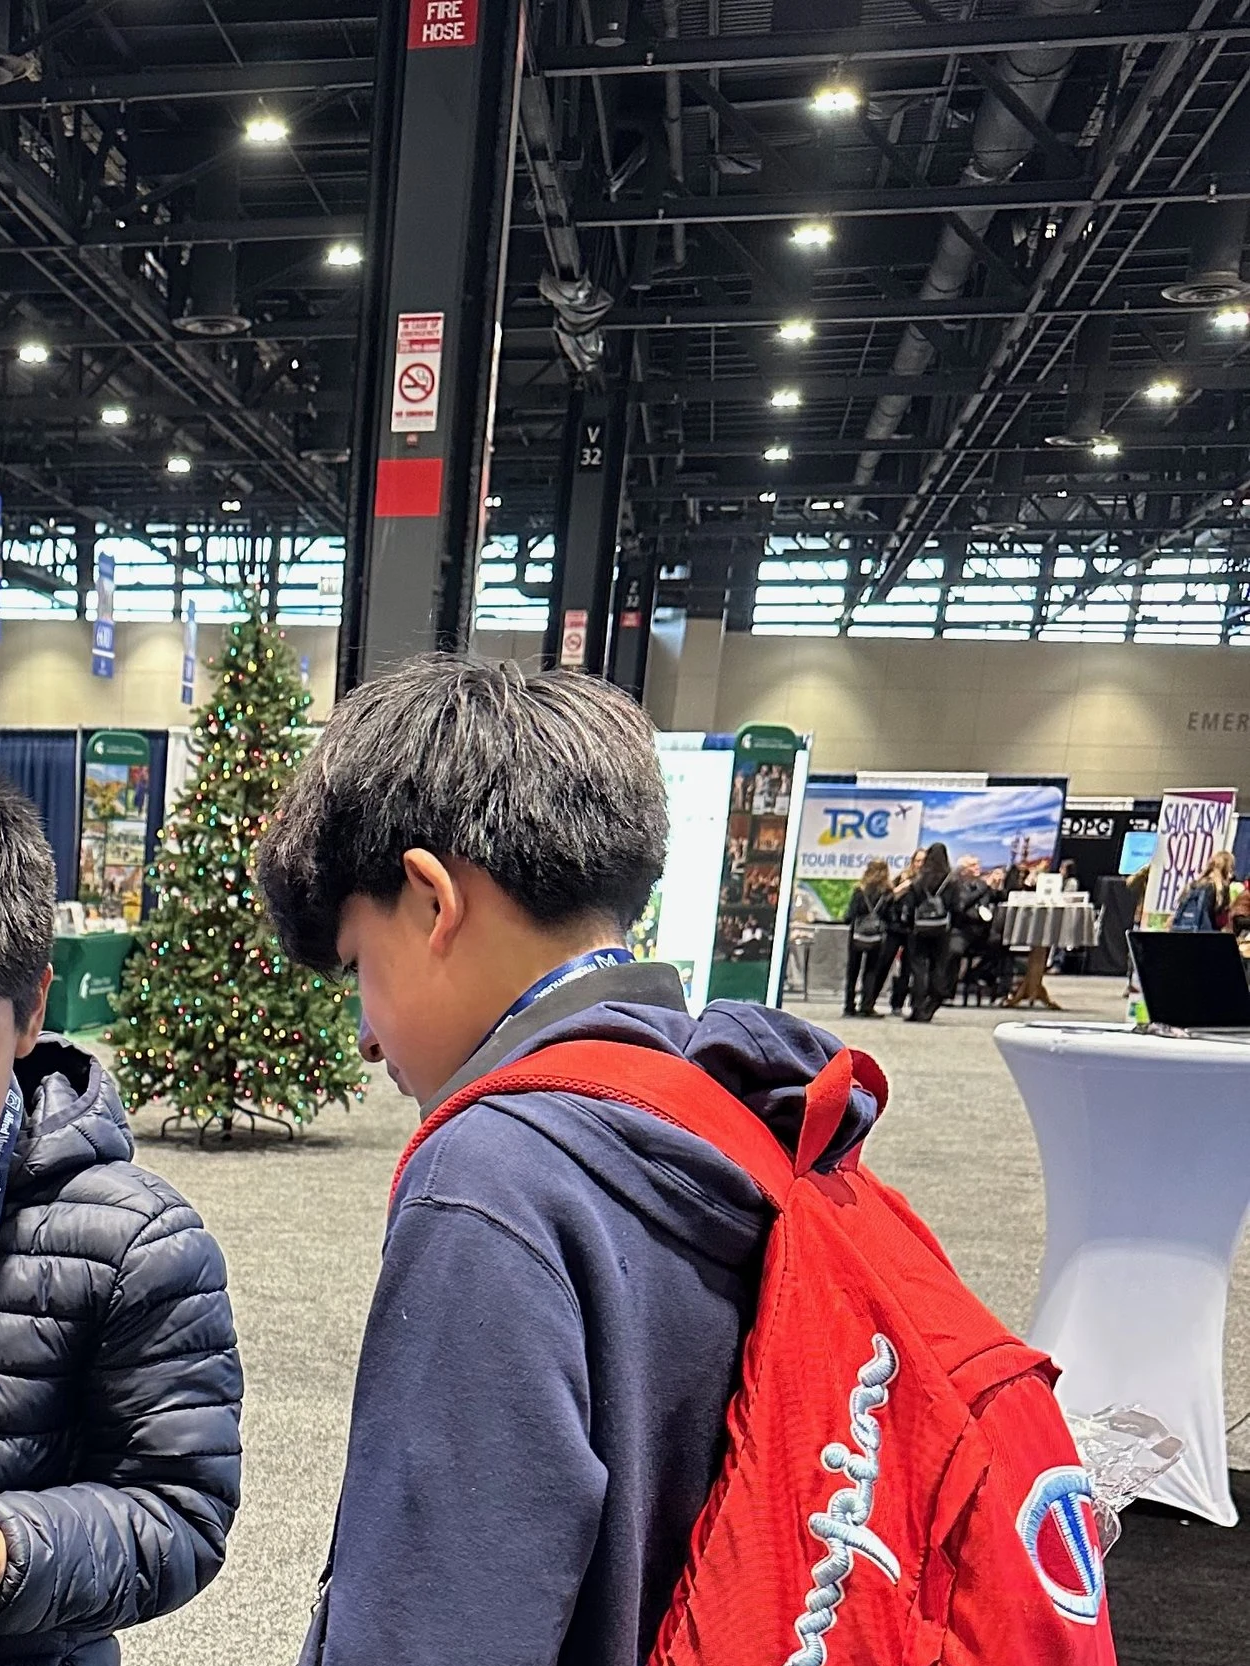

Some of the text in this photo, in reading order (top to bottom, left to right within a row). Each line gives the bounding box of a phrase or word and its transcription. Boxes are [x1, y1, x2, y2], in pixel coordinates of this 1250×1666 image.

[427, 0, 463, 20] FIRE
[422, 21, 466, 42] HOSE
[587, 425, 600, 443] V
[580, 447, 602, 466] 32
[823, 807, 891, 839] TRC
[1161, 801, 1227, 836] SARCASM
[801, 852, 836, 868] TOUR
[1164, 832, 1214, 874] SOLD
